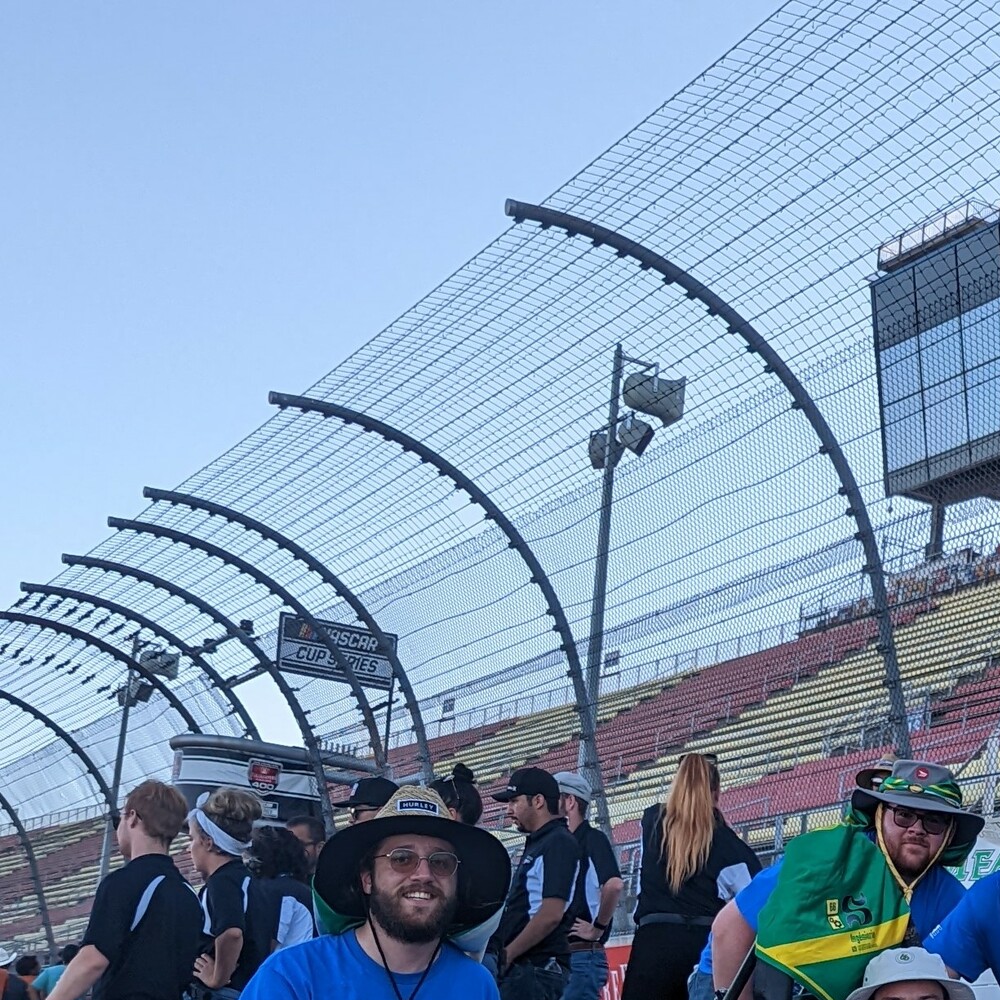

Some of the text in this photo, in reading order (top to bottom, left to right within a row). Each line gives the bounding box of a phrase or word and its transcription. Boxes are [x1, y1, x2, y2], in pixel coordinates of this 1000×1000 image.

[323, 627, 378, 652] ASCAR
[296, 646, 327, 662] CUP
[252, 781, 275, 791] 400
[402, 802, 434, 811] HURLEY
